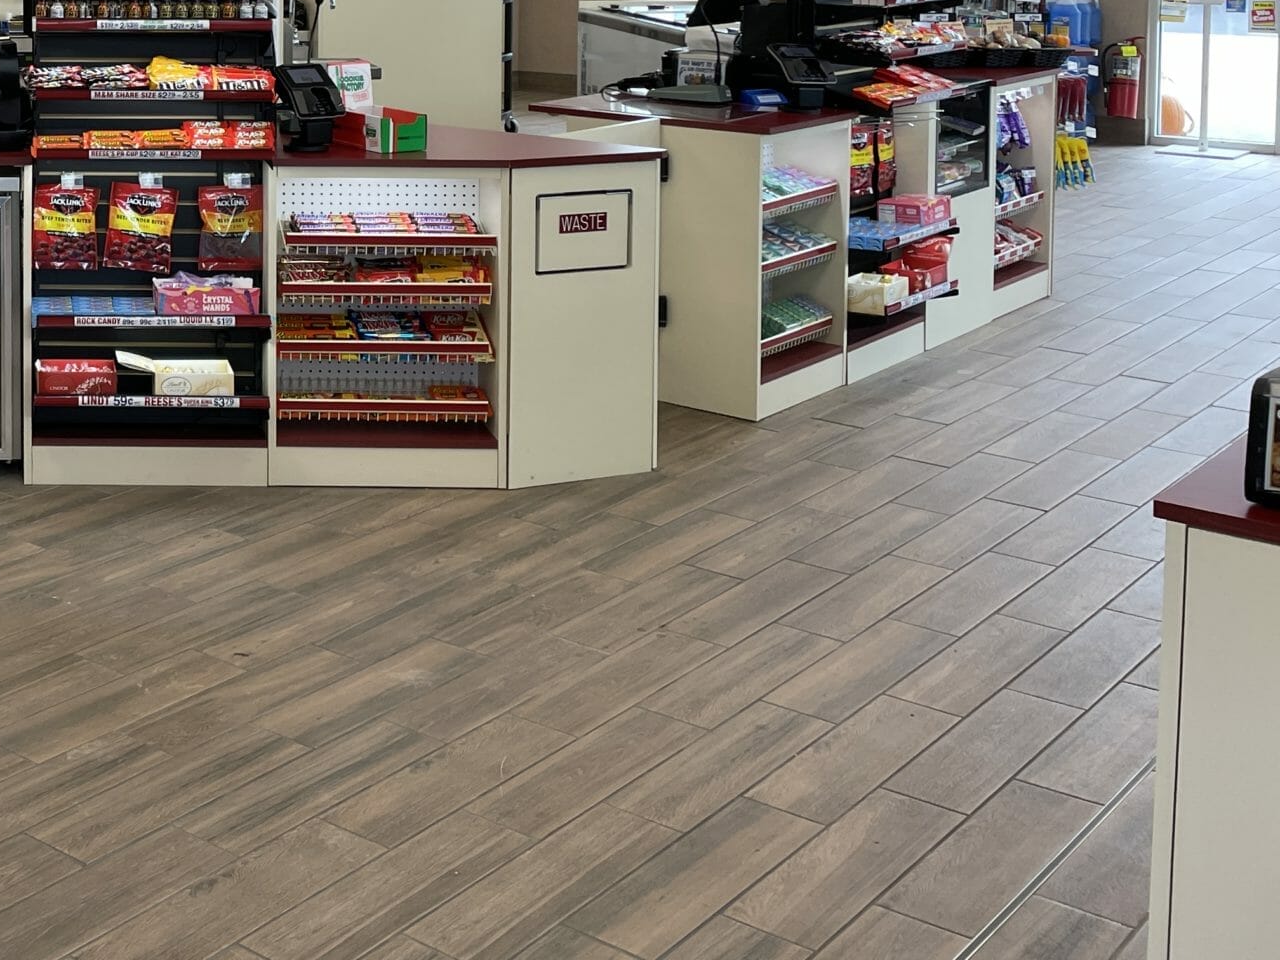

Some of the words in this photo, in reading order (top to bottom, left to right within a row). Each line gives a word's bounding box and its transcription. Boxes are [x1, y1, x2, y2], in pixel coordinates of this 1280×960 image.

[94, 91, 113, 99] M&M
[115, 91, 138, 99] SHARE
[140, 91, 157, 99] SIZE
[51, 197, 67, 206] JACK
[127, 197, 143, 206] JACK
[561, 213, 606, 232] WASTE
[202, 295, 234, 304] CRYSTAL
[202, 304, 231, 312] WANDS
[76, 317, 96, 325] ROCK
[97, 316, 121, 325] CANDY
[178, 316, 203, 325] LIQUID
[81, 396, 110, 407] LINDT
[144, 397, 183, 407] REESE'S
